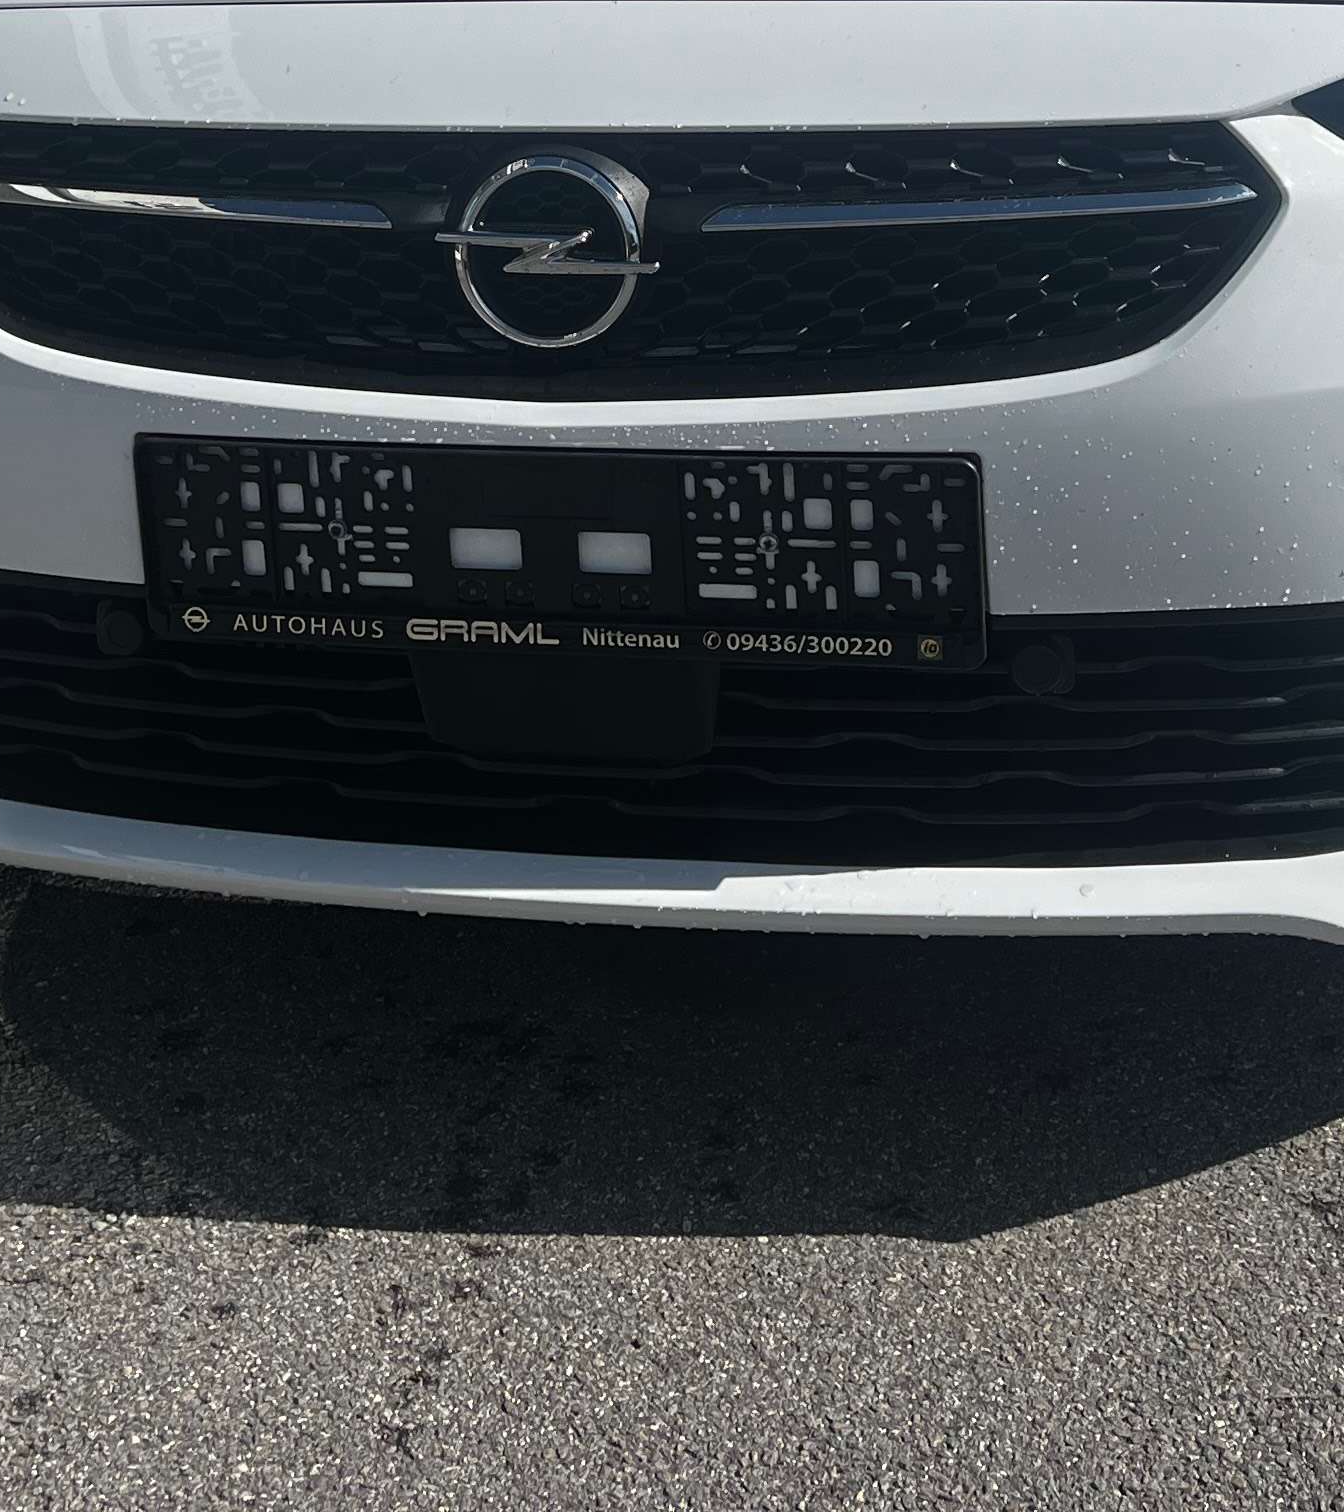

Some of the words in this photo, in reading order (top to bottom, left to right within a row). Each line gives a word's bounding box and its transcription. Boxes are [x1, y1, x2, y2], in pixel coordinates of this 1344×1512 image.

[233, 613, 384, 639] AUTOHAUS
[406, 618, 560, 645] GRAML
[582, 627, 680, 649] Nittenau
[726, 633, 893, 657] 09436/300220
